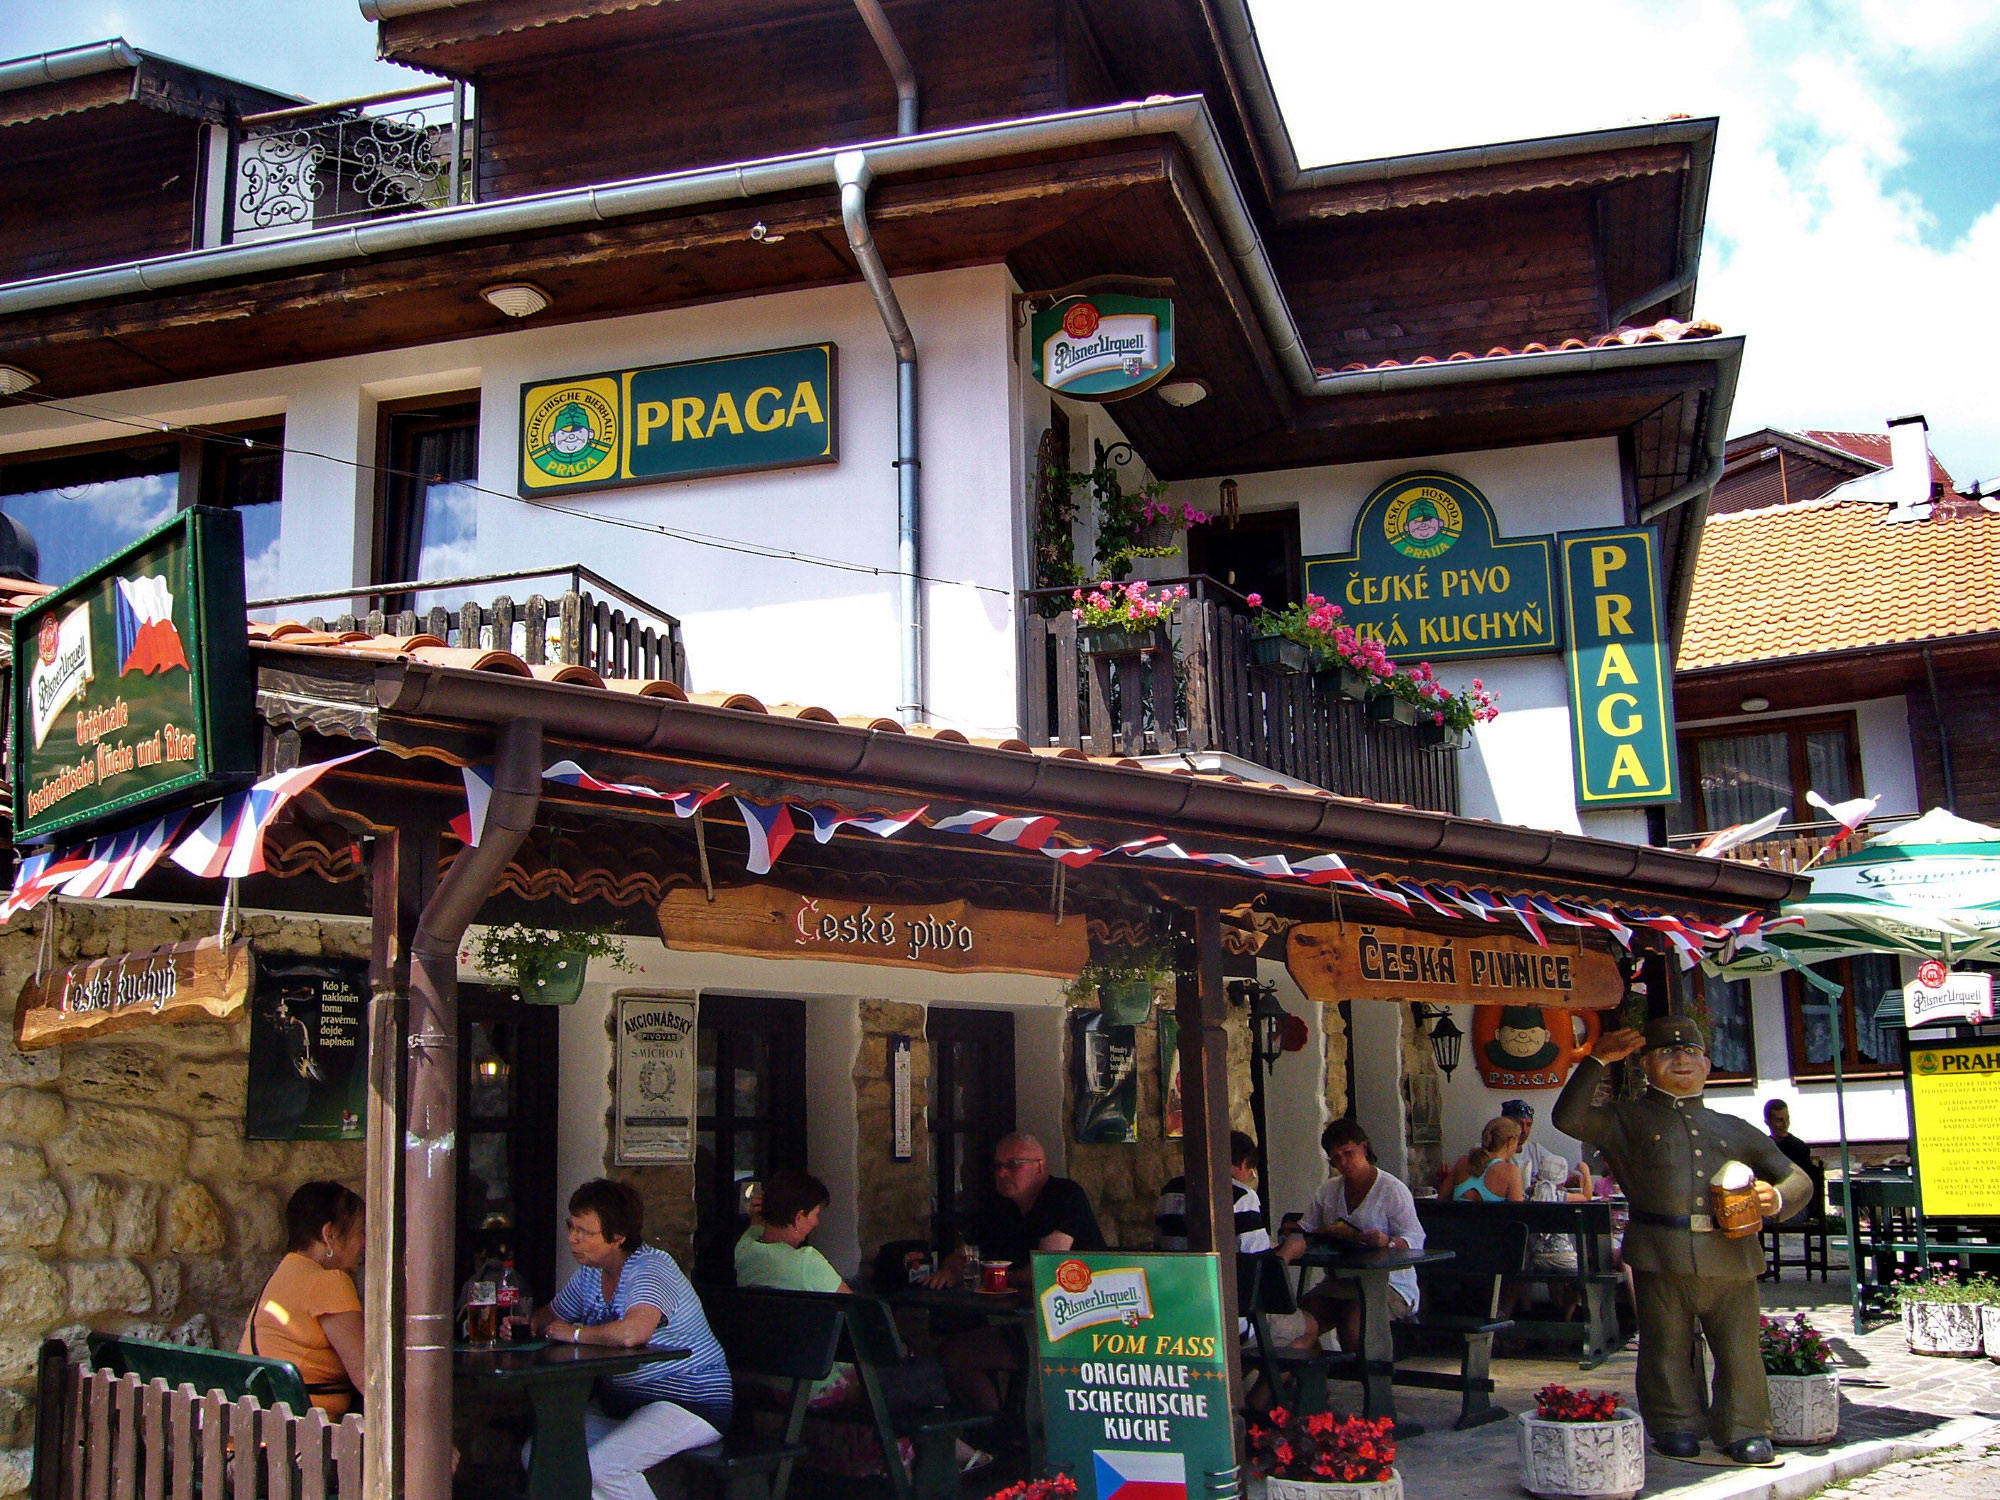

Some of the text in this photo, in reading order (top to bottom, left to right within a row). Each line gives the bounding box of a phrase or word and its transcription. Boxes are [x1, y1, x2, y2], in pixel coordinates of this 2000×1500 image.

[1055, 335, 1144, 374] Pilsner Urquell
[530, 392, 613, 450] TSCHECHISCHE BIERHALLE
[636, 381, 825, 447] PRAGA
[546, 457, 598, 476] PRAGA
[1422, 489, 1460, 526] HOSPODA
[1404, 543, 1450, 559] PRAHA
[1345, 566, 1430, 605] ČESKÉ
[1420, 602, 1543, 644] KUCHYŇ
[39, 675, 63, 722] Pilsner
[61, 635, 85, 676] Urquell
[1591, 545, 1650, 789] PRAGA
[76, 695, 128, 746] Originale
[27, 723, 196, 819] tschechische Küche und Bier
[795, 895, 974, 960] České pivo
[1359, 926, 1573, 990] ČESKÁ PIVNICE
[114, 957, 177, 1015] kuchyň
[322, 981, 349, 993] Kdo je
[1913, 989, 1982, 1015] Pilsner Urquell
[321, 1003, 343, 1013] tomu
[320, 1025, 343, 1038] dojde
[1489, 1071, 1559, 1086] PRAGA
[1942, 1053, 2000, 1071] PRAH
[1054, 1287, 1138, 1325] Pilsner Urquell
[1092, 1334, 1216, 1357] VOM FASS
[1081, 1363, 1190, 1388] ORIGINALE
[1065, 1389, 1209, 1418] TSCHECHISCHE
[1104, 1417, 1171, 1442] KÜCHE
